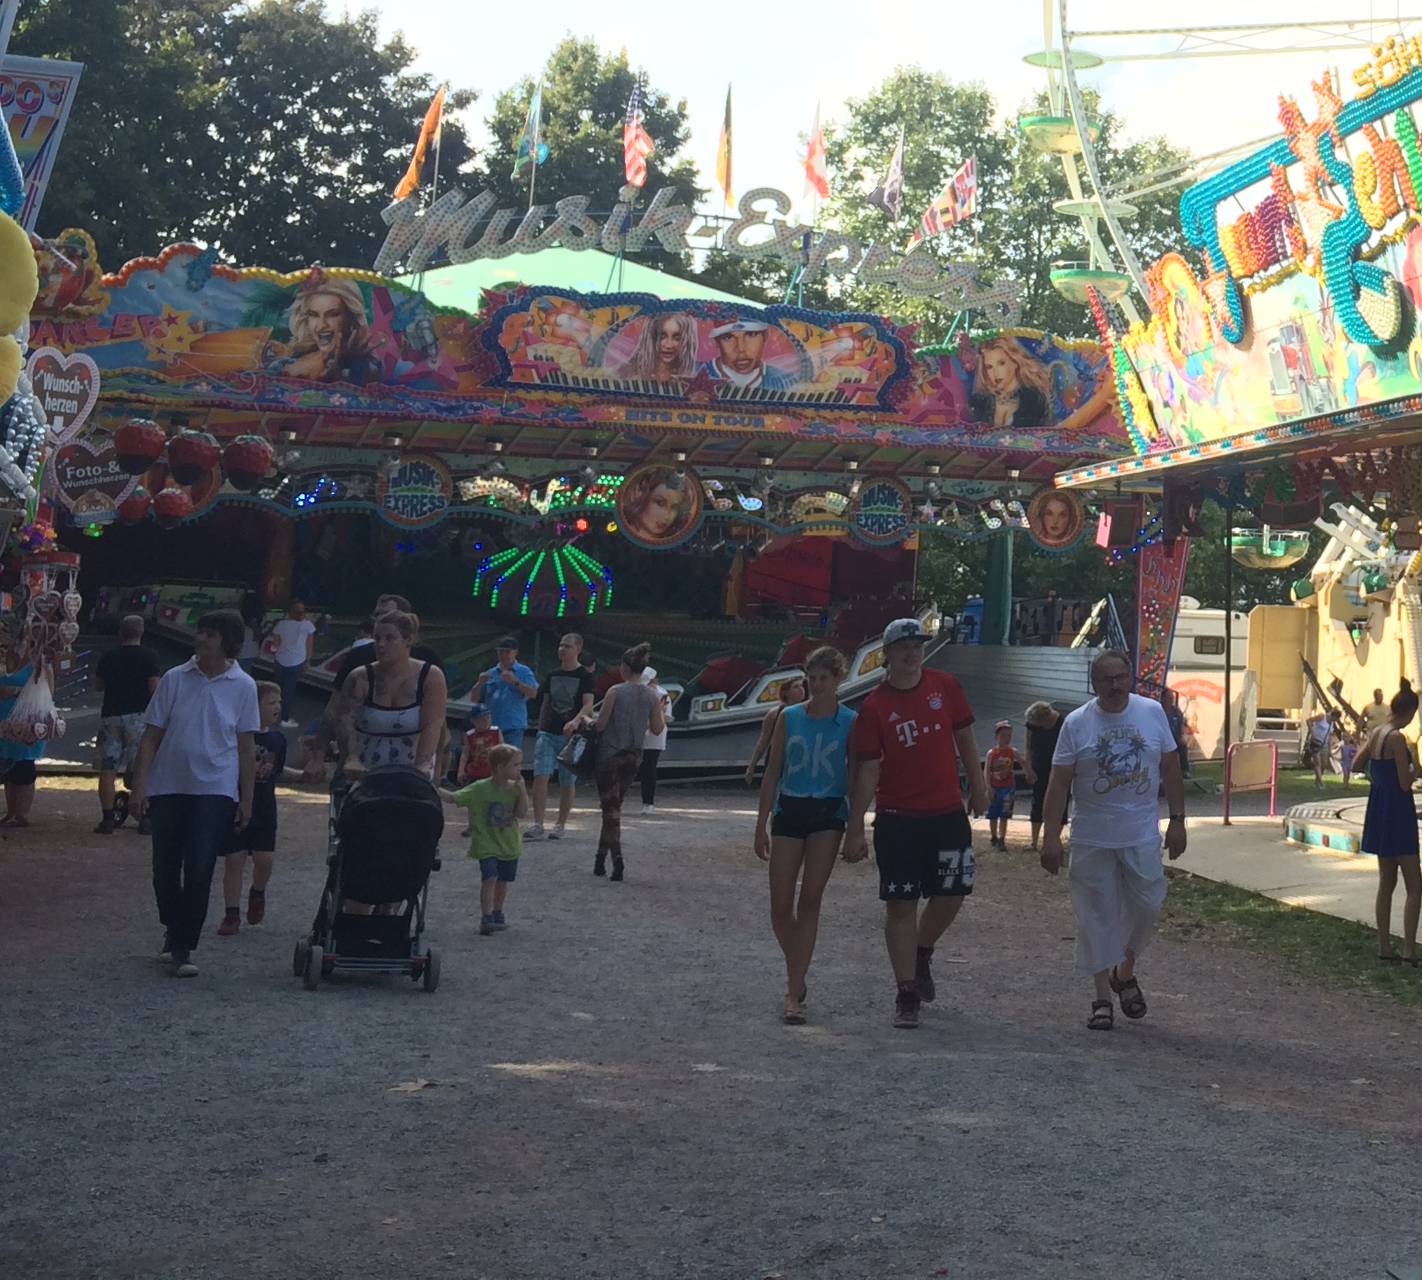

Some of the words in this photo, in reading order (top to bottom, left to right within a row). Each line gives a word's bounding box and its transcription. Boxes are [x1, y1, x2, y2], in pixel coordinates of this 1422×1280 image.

[43, 372, 84, 395] Wunsch-
[44, 396, 79, 415] herzen
[677, 411, 706, 425] ON
[383, 494, 446, 518] EXPRESS
[856, 513, 906, 535] EXPRESS
